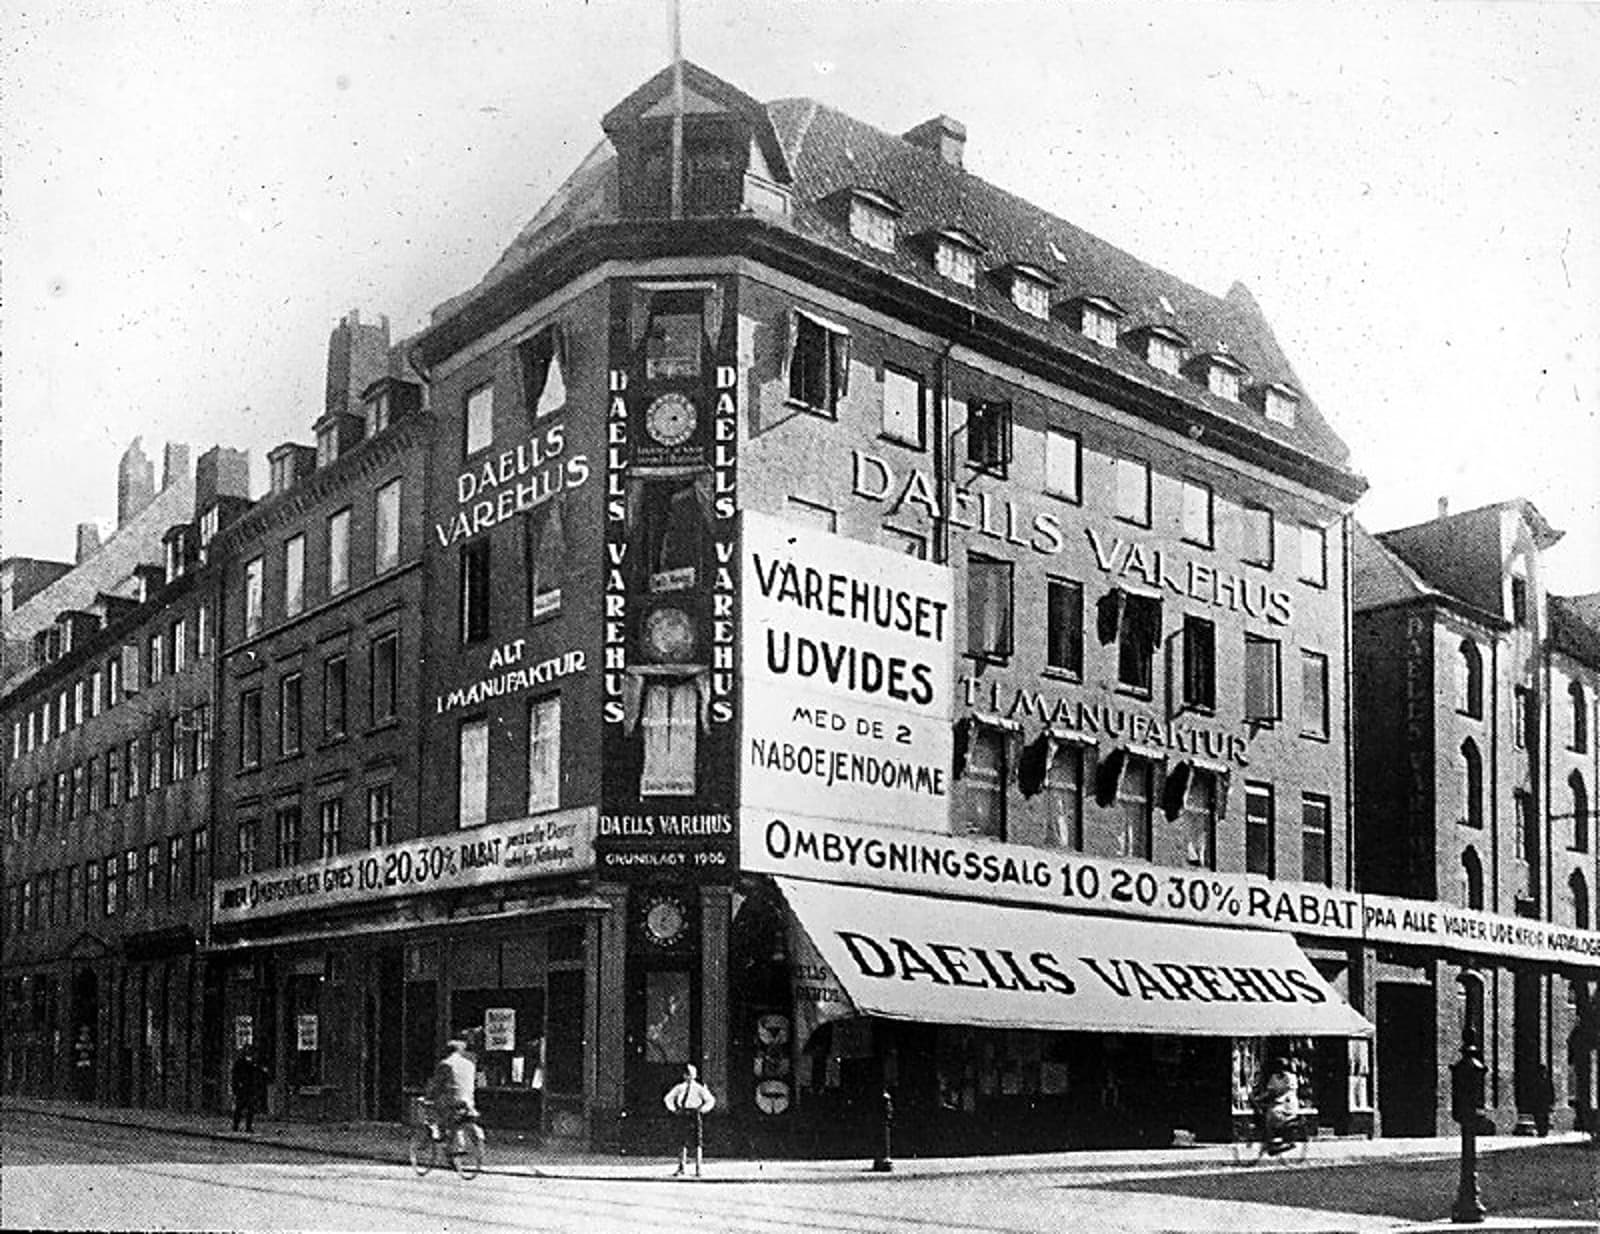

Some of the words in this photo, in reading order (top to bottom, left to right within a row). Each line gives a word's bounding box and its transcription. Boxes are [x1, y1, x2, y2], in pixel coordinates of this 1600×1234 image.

[458, 424, 564, 502] DAELLS
[608, 370, 629, 522] DAELLS
[715, 366, 737, 520] DAELLS
[436, 455, 589, 546] VAREHUS
[852, 450, 1064, 554] DAELLS
[1085, 527, 1292, 626] VAREHUS
[603, 543, 627, 724] VAREHUS
[711, 543, 735, 723] VAREHUS
[753, 553, 947, 641] VAREHUSET
[446, 651, 586, 709] MANUFAKTUR
[490, 640, 525, 669] ALT
[767, 628, 933, 704] UDVIDES
[793, 707, 846, 731] MED
[856, 718, 883, 739] DE
[897, 725, 911, 744] 2
[1008, 688, 1249, 766] MANUFAKTUR
[751, 738, 945, 796] NABOEJENDOMME
[461, 838, 501, 870] RABAT
[600, 815, 655, 836] DAELLS
[659, 814, 732, 835] VAREHUS
[765, 820, 1051, 888] OMBYGNINGSSALG
[1249, 886, 1357, 930] RABAT
[1366, 907, 1396, 929] PAA
[1403, 910, 1437, 932] ALLE
[1443, 915, 1487, 941] VARER
[835, 931, 1076, 994] DAELLS
[1078, 957, 1327, 1004] VAREHUS
